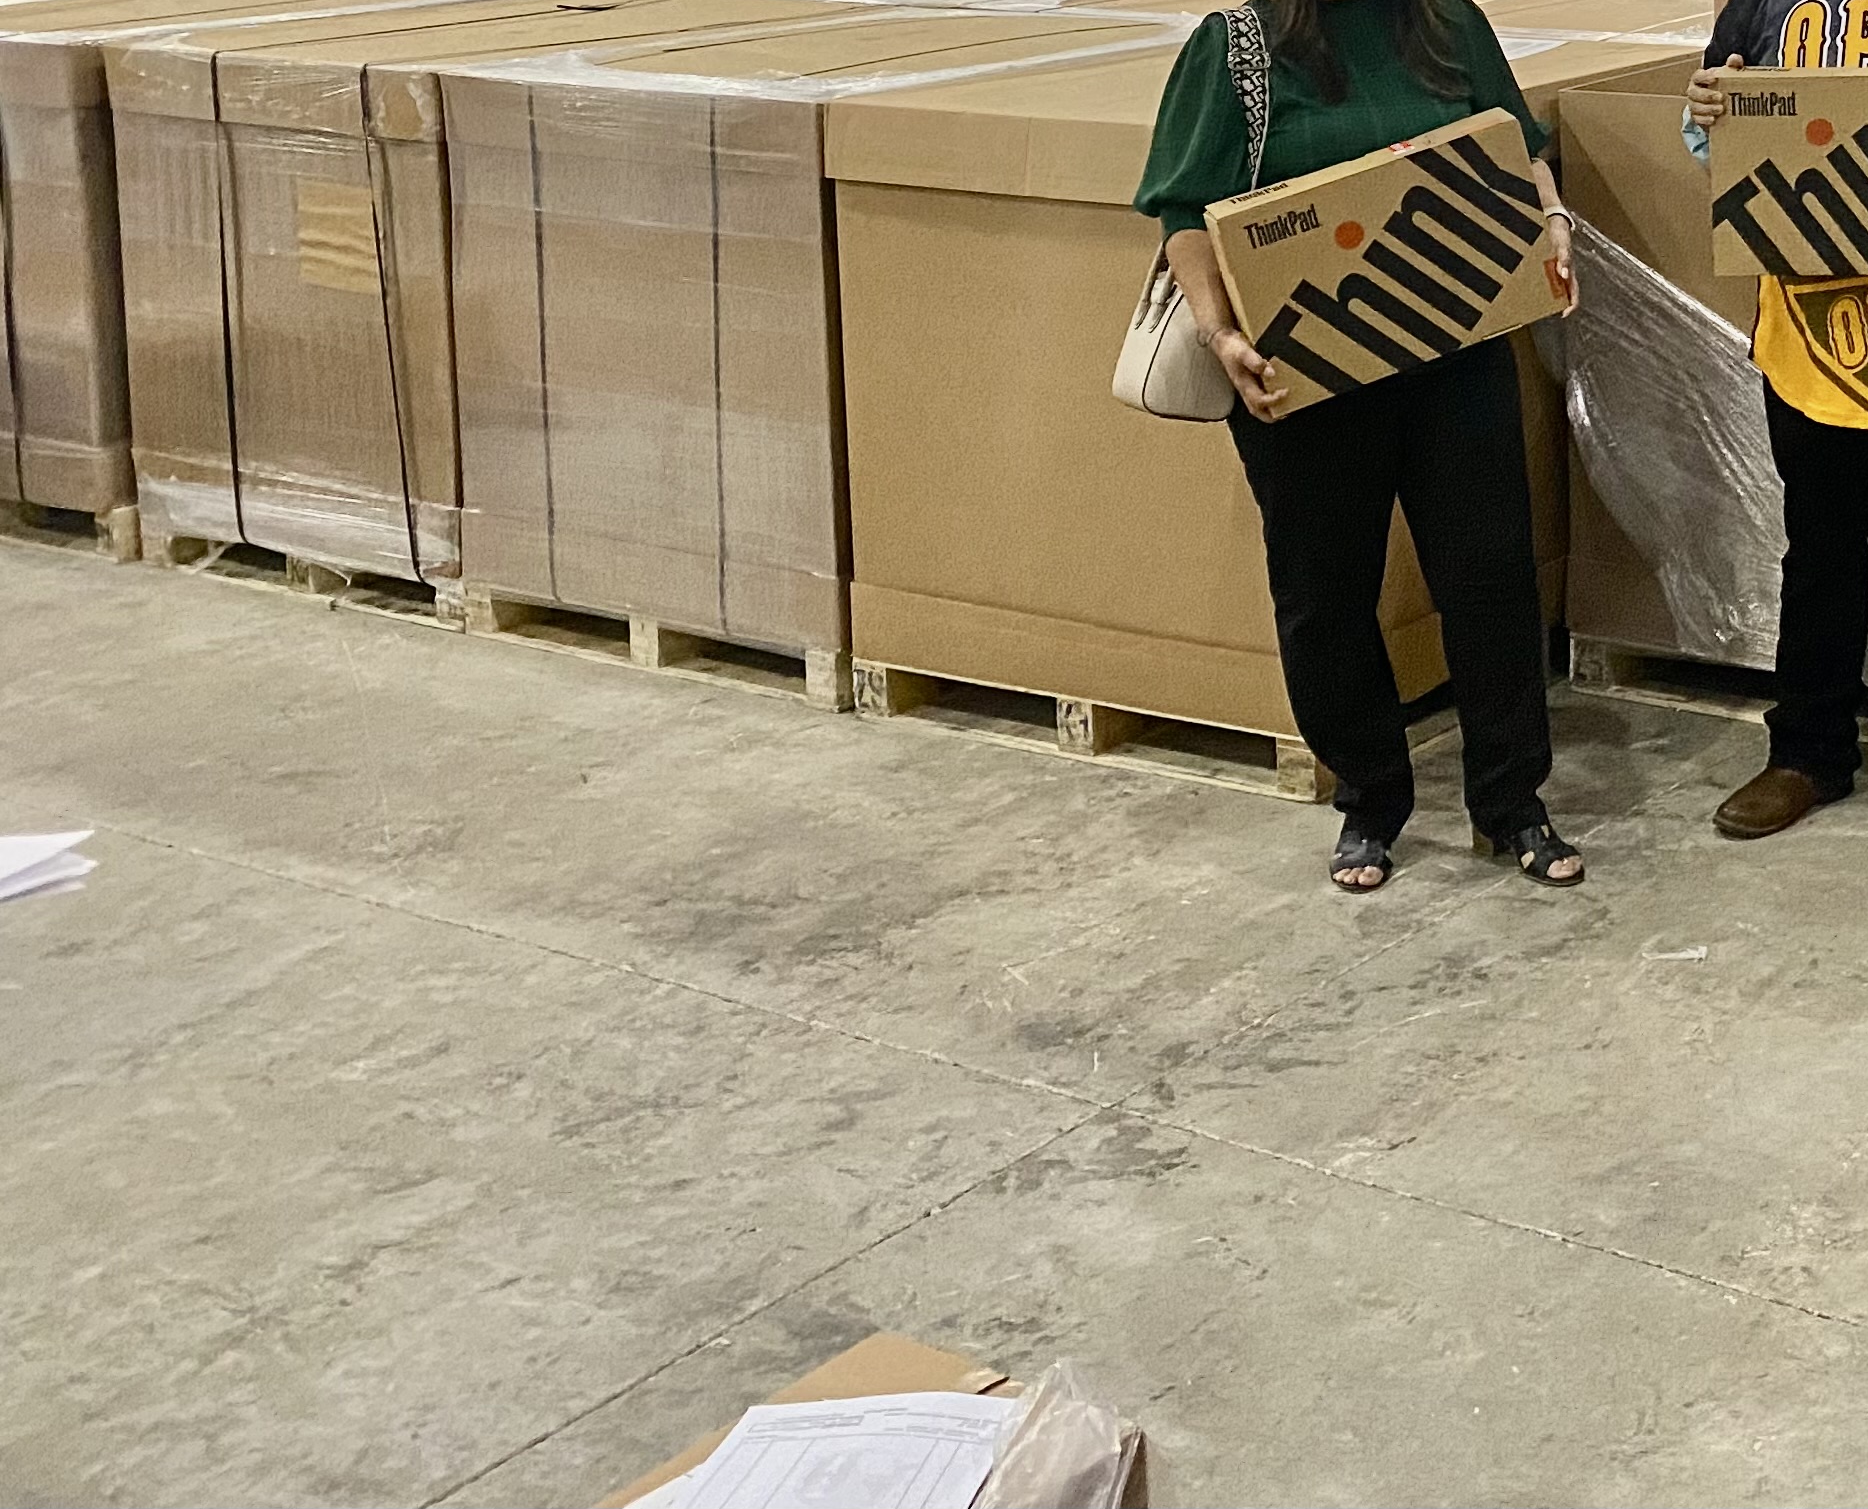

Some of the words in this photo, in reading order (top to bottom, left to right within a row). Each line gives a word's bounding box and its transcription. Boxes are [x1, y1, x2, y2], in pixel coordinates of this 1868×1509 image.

[1729, 91, 1798, 117] ThinkPad
[1243, 203, 1322, 249] ThinkPad
[1254, 134, 1544, 396] Think
